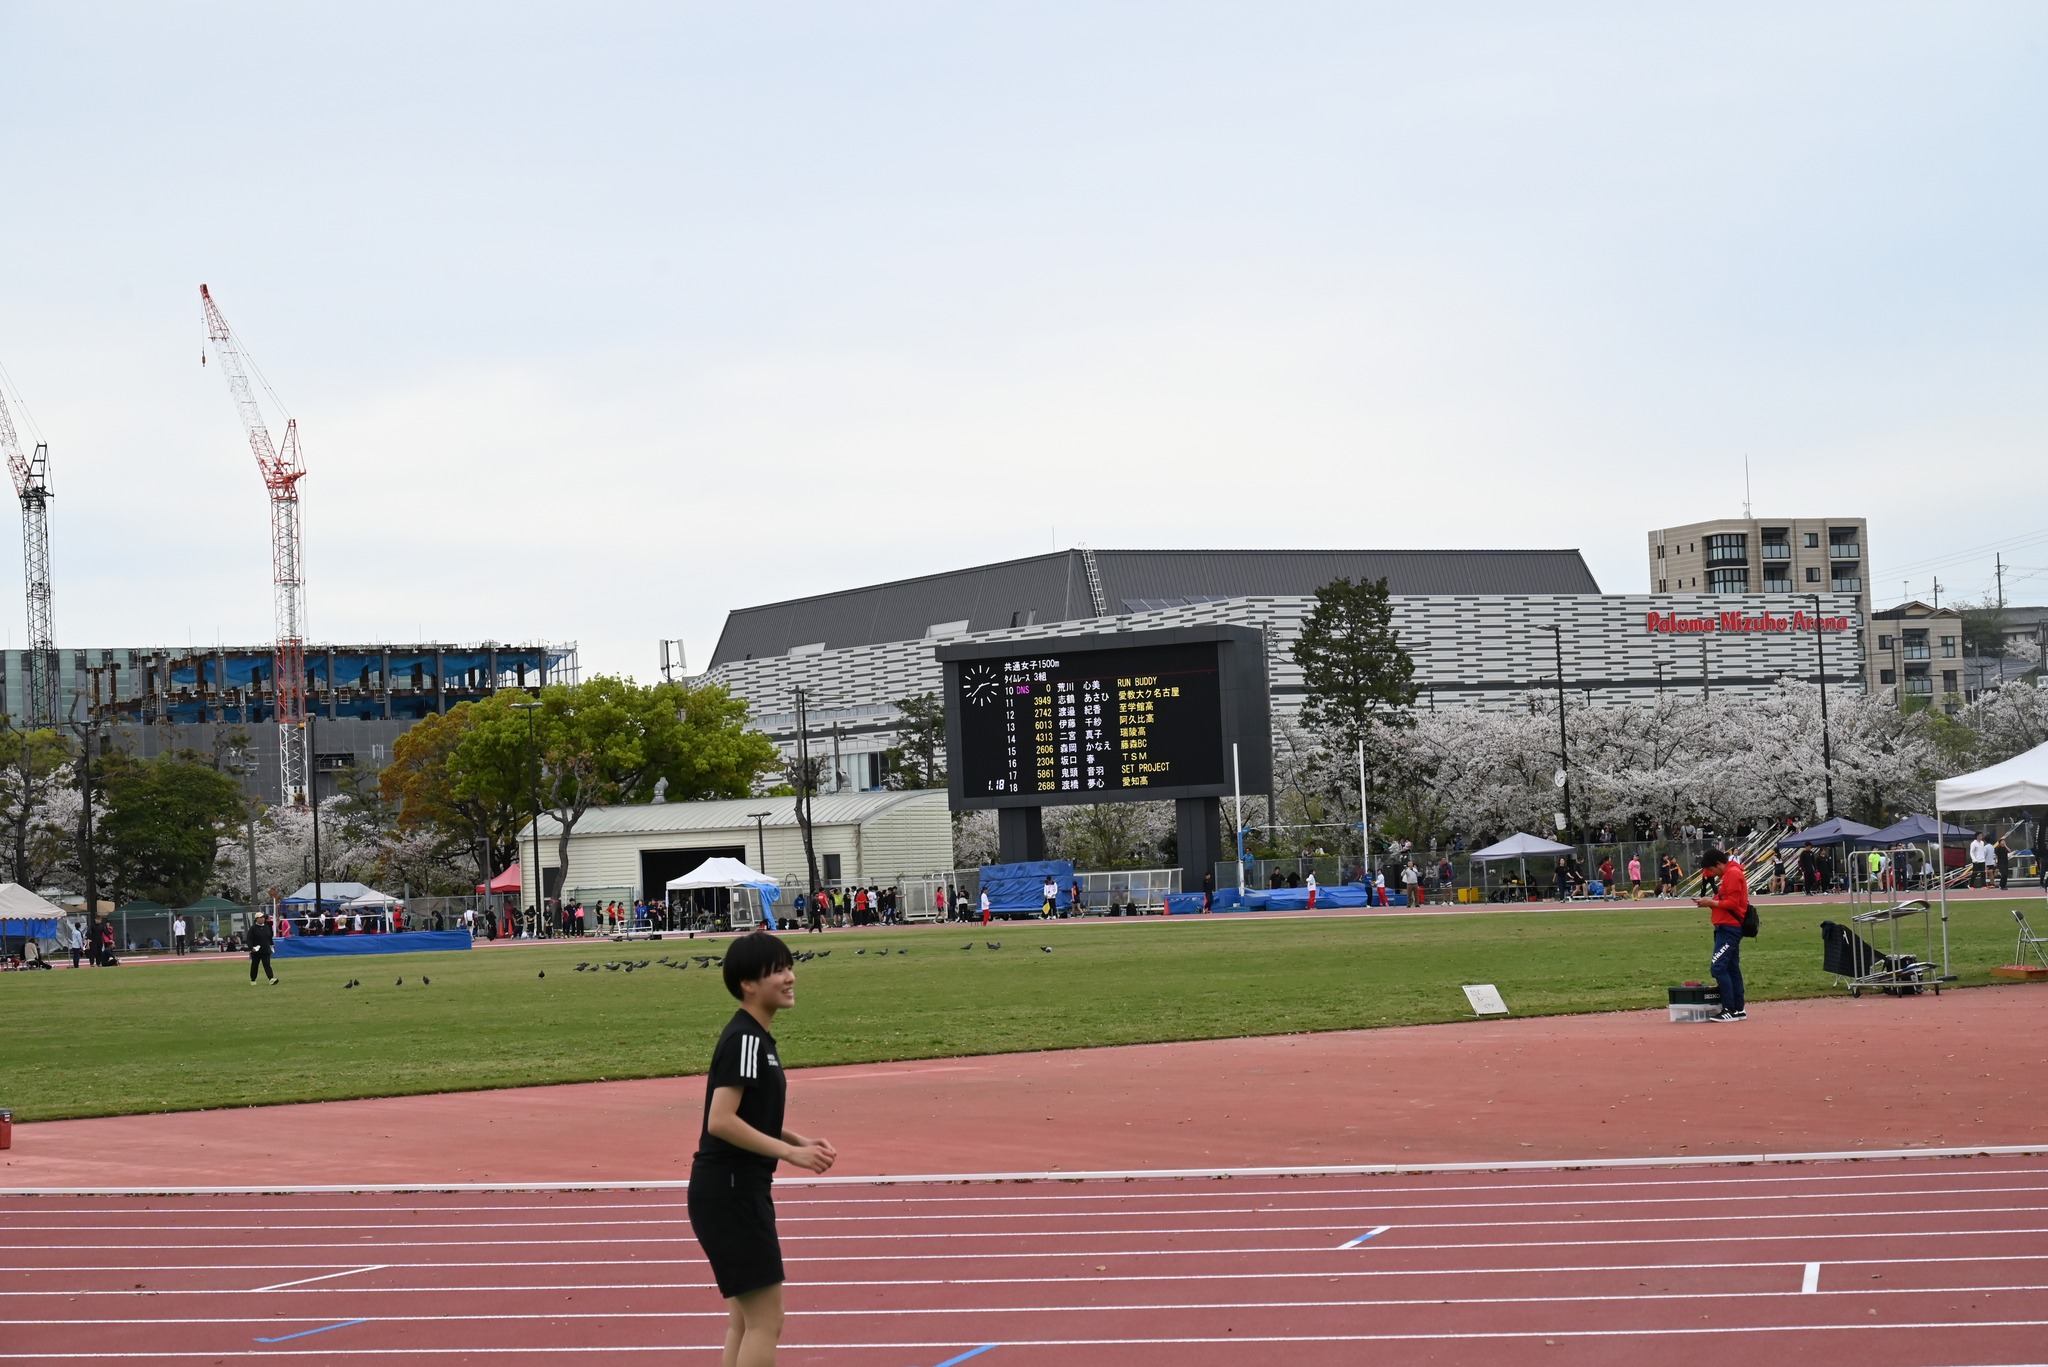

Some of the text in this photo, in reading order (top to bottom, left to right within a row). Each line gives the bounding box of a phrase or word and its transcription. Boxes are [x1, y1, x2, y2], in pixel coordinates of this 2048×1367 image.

[1647, 610, 1848, 632] Paloma Mizuho Arena
[1004, 659, 1059, 671] 共通女子1500m
[1034, 672, 1047, 681] 3組
[1006, 687, 1013, 695] 10
[1017, 686, 1029, 694] DNS
[1057, 682, 1074, 692] 荒川
[1083, 680, 1100, 690] 心美
[1118, 678, 1131, 687] RUN
[1135, 677, 1157, 686] BUDDY
[1006, 699, 1013, 707] 11
[1034, 696, 1051, 705] 3949
[1084, 693, 1109, 702] あさひ
[1007, 711, 1014, 719] 12
[1035, 708, 1051, 717] 2742
[1084, 704, 1101, 715] 紀香
[1119, 701, 1153, 712] 至学館高
[1007, 723, 1015, 731] 13
[1035, 721, 1052, 729] 6013
[1059, 719, 1076, 729] 伊藤
[1120, 714, 1154, 725] 阿久比高
[1008, 735, 1015, 743] 14
[1036, 733, 1053, 741] 4313
[1060, 731, 1076, 740] 二宮
[1086, 730, 1102, 739] 真子
[1008, 747, 1016, 755] 15
[1036, 745, 1053, 754] 2606
[1060, 743, 1077, 753] 森岡
[1086, 741, 1111, 751] かなえ
[1009, 759, 1017, 767] 16
[1037, 757, 1054, 766] 2304
[1061, 756, 1077, 765] 坂口
[1087, 754, 1094, 764] 春
[1009, 762, 1169, 780] 17 5861 鬼頭 音羽 SET PROJECT
[1010, 783, 1018, 792] 18
[1038, 781, 1055, 790] 2688
[1088, 779, 1104, 789] 夢心
[1122, 776, 1148, 786] 愛知高
